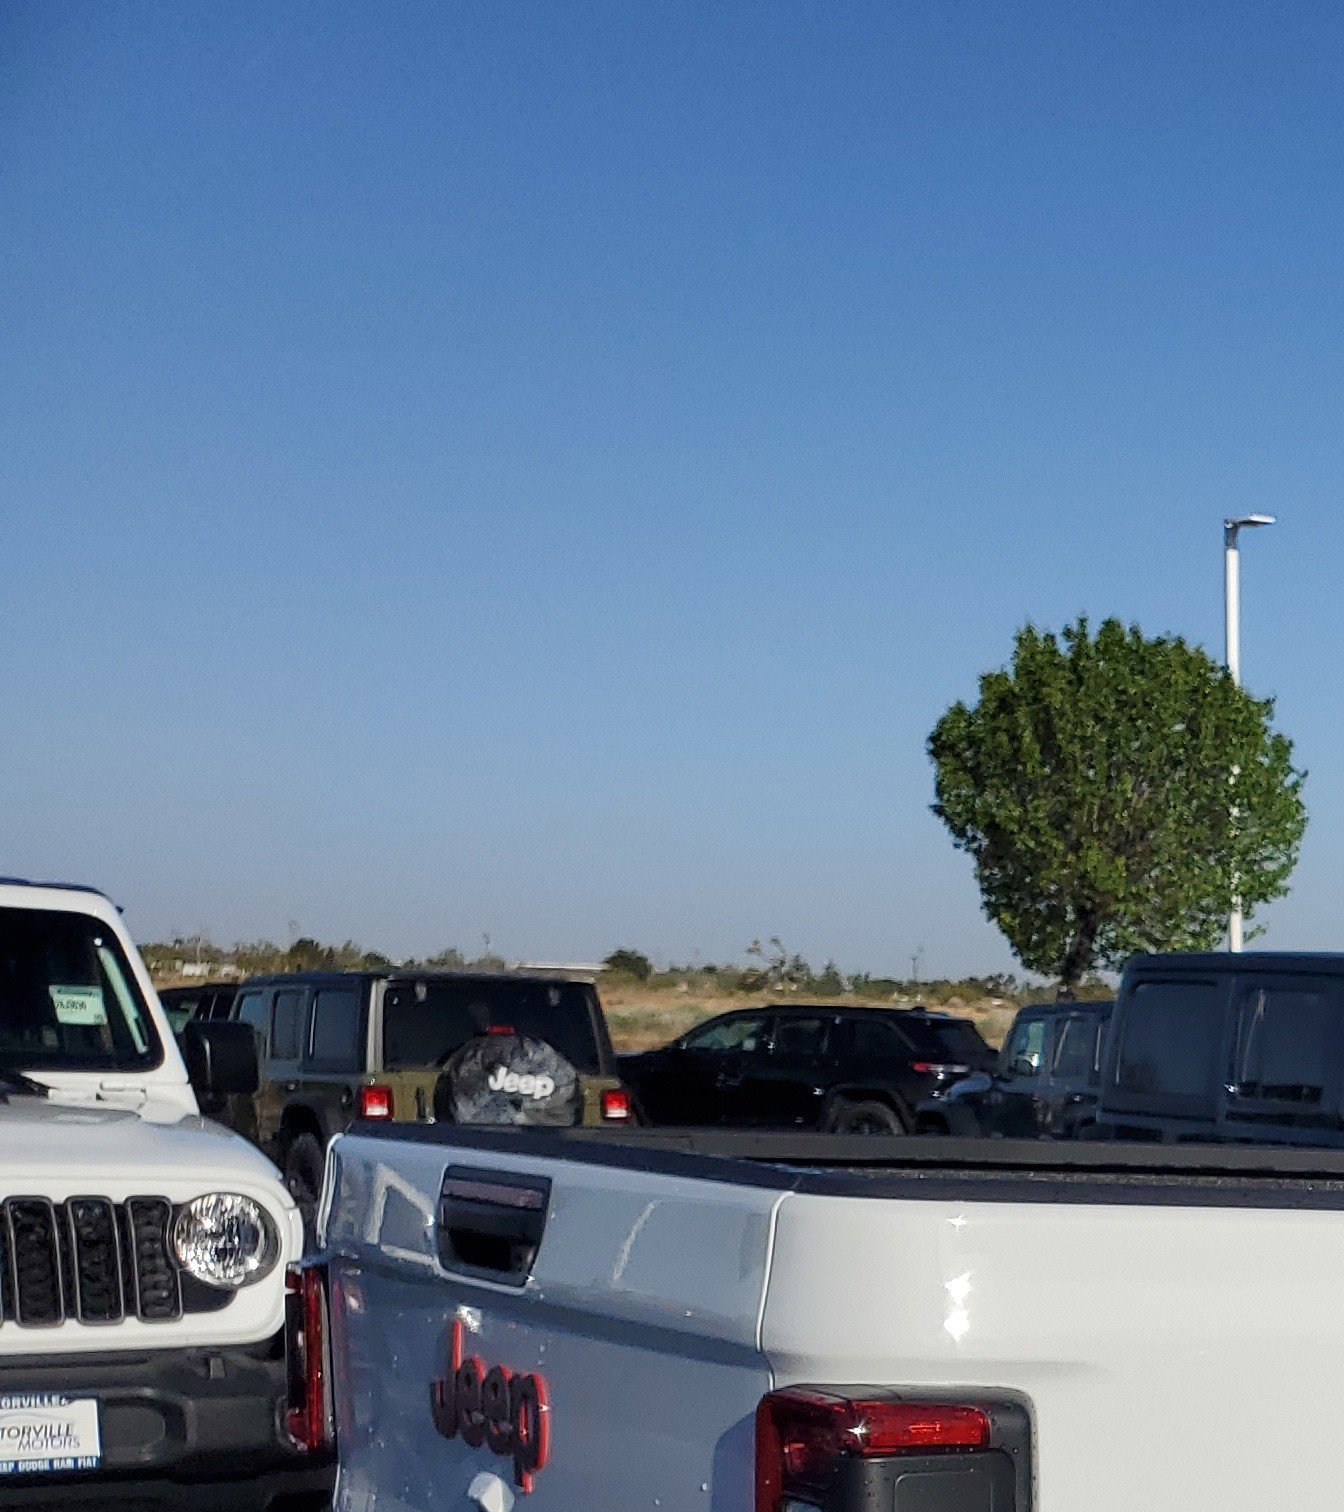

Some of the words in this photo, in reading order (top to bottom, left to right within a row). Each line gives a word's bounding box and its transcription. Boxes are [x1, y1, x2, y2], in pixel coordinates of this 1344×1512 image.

[488, 1065, 555, 1100] Jeep
[430, 1318, 552, 1497] Jeep
[18, 1435, 80, 1452] MOTORS
[18, 1459, 50, 1472] DODGE
[78, 1456, 97, 1469] FIAT
